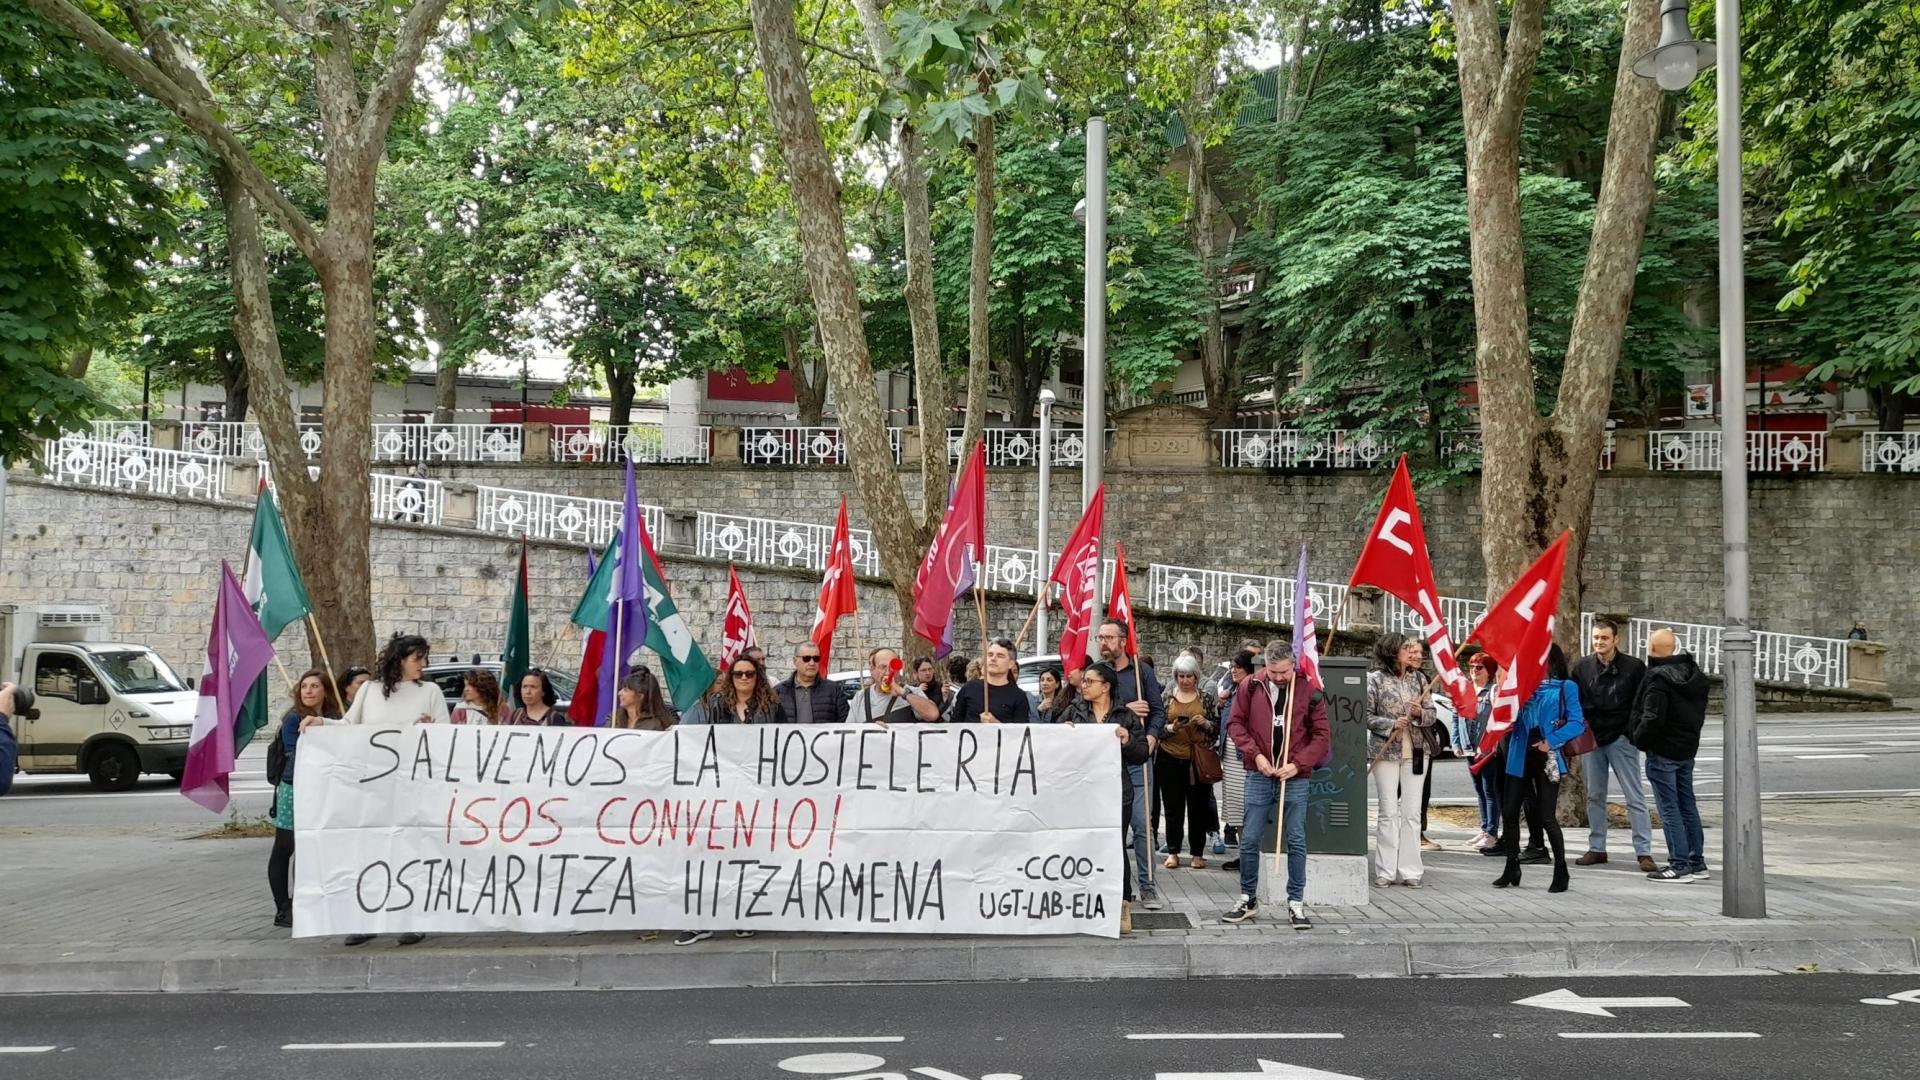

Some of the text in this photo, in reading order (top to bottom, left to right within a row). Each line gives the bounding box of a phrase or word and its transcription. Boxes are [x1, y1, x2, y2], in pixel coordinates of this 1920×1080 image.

[359, 725, 1038, 796] SALVEMOS LA HOSTELERIA
[446, 789, 842, 858] ¡SOS CONVENIO!
[355, 853, 945, 924] OSTALARITZA HITZARMENA
[979, 889, 1105, 920] UGT-LAB-ELA
